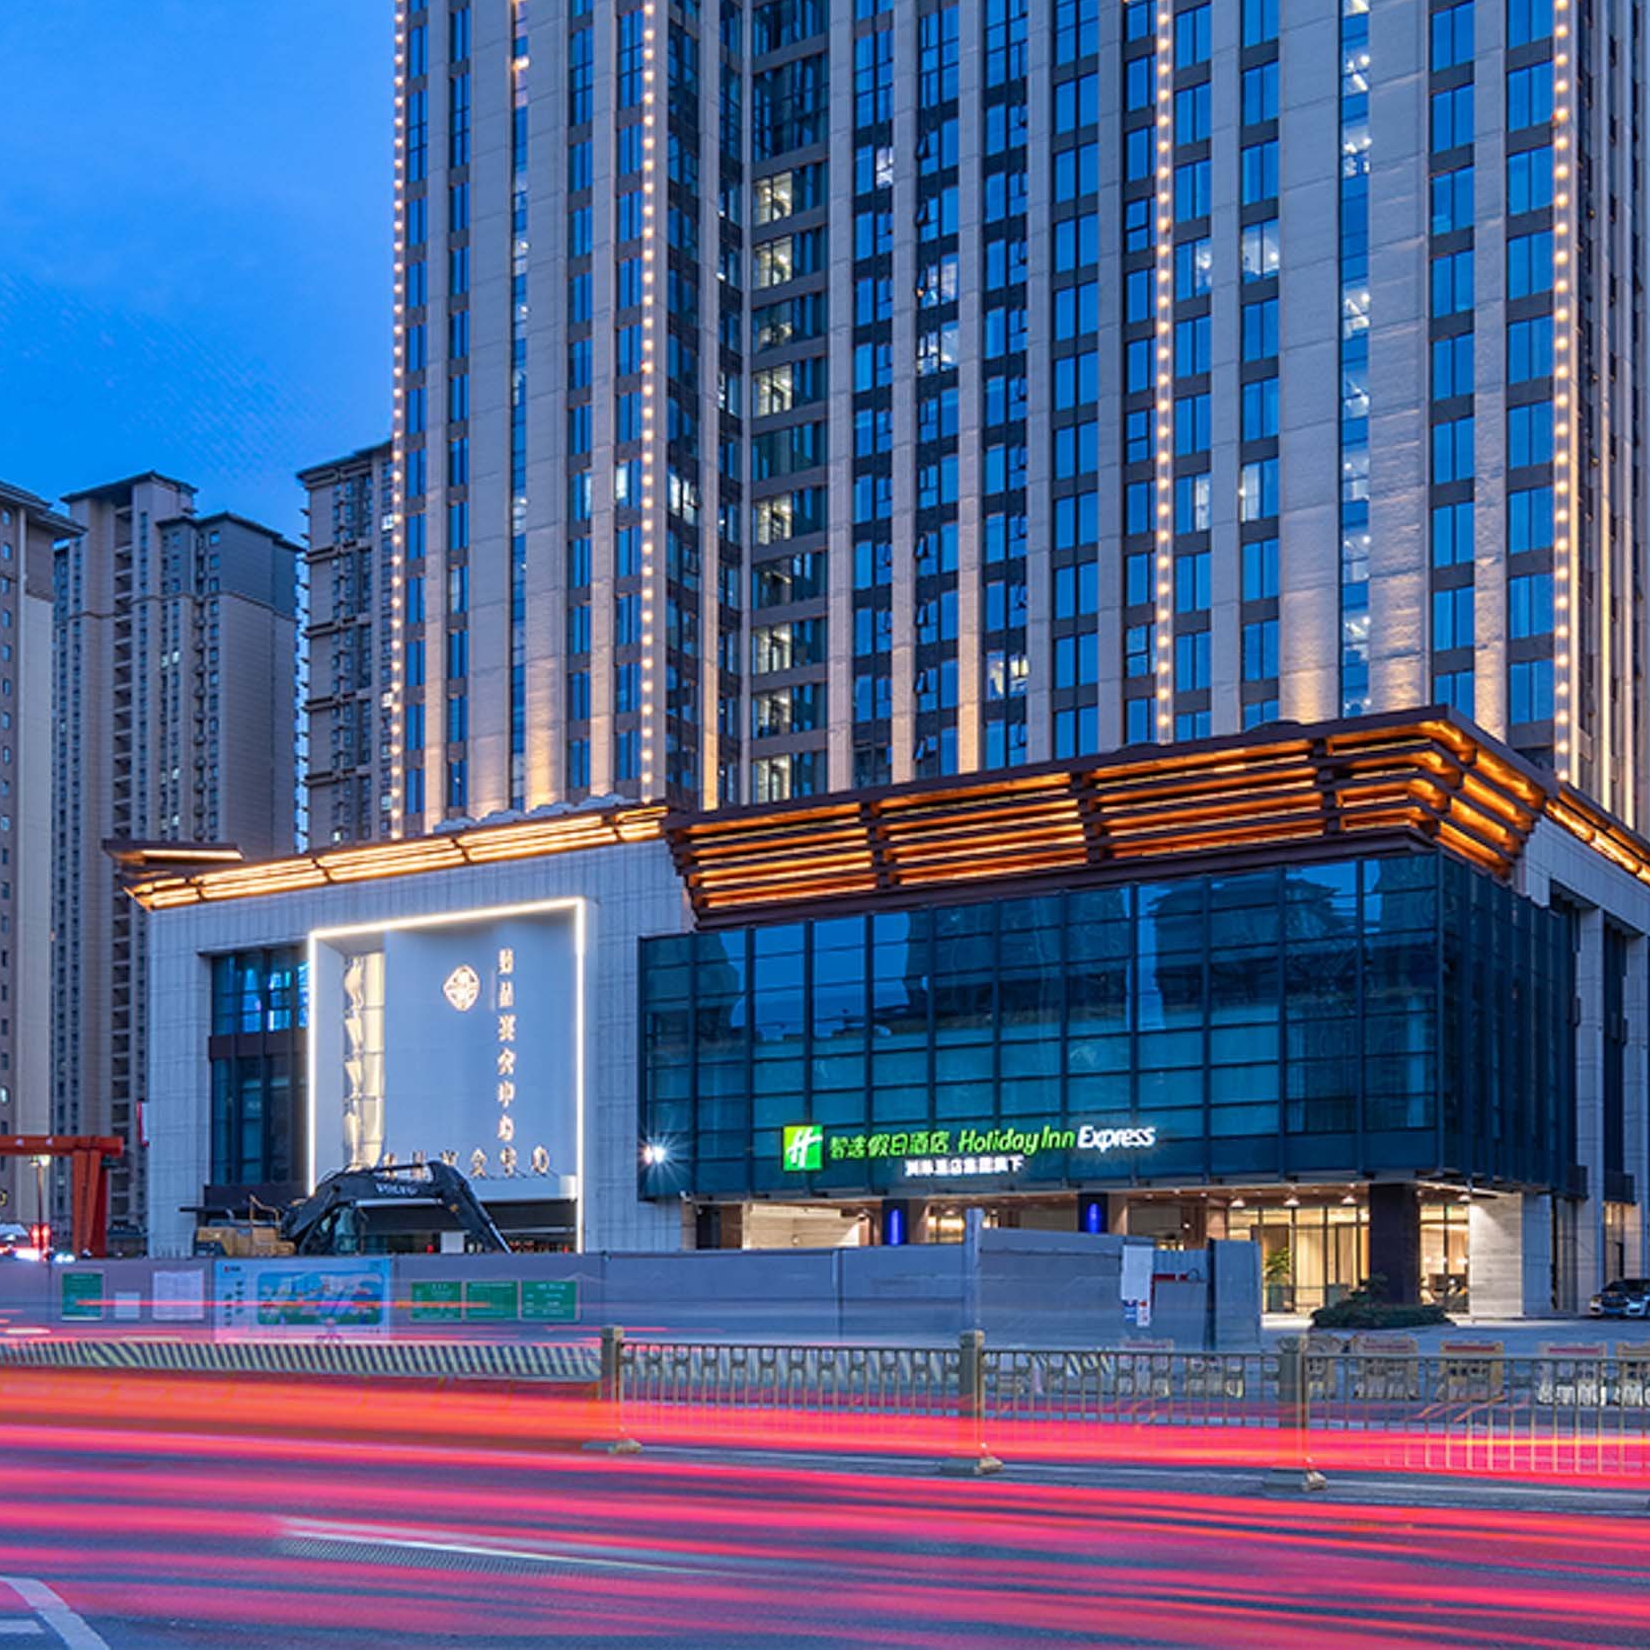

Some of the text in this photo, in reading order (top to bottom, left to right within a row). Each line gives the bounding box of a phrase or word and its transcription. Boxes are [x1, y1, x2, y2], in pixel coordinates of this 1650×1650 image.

[958, 1127, 1040, 1155] Holiday
[1041, 1126, 1075, 1148] Inn
[1077, 1125, 1156, 1152] Express
